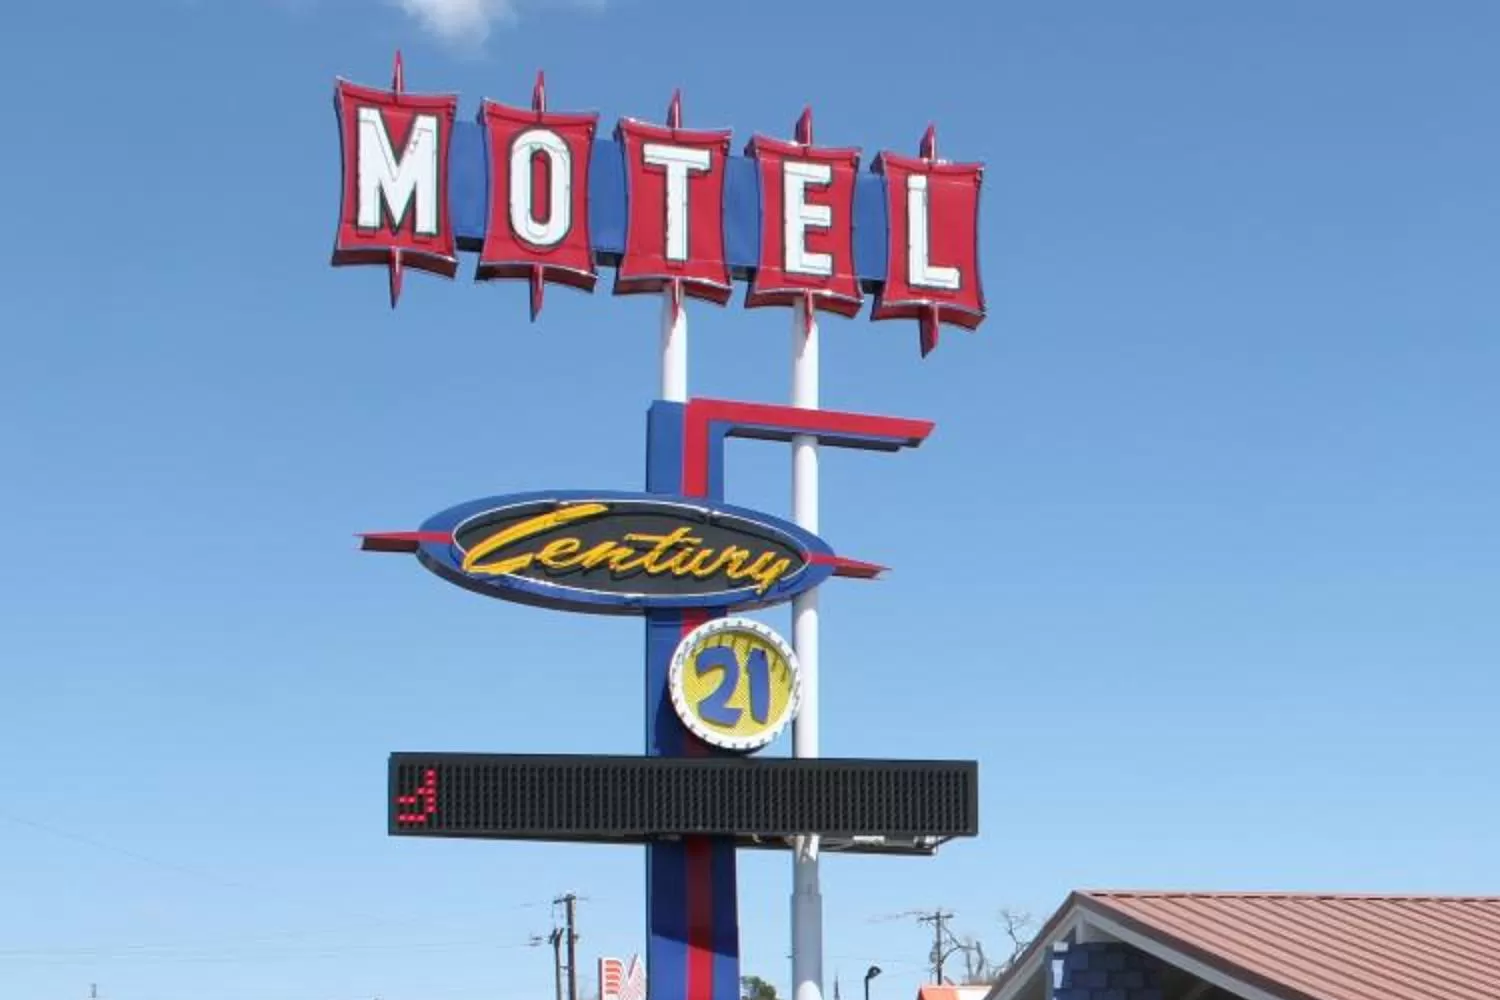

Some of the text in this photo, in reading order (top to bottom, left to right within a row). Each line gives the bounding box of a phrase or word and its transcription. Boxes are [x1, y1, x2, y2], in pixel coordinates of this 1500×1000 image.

[355, 104, 962, 290] MOTEL
[462, 502, 791, 594] Century
[694, 645, 770, 728] 21
